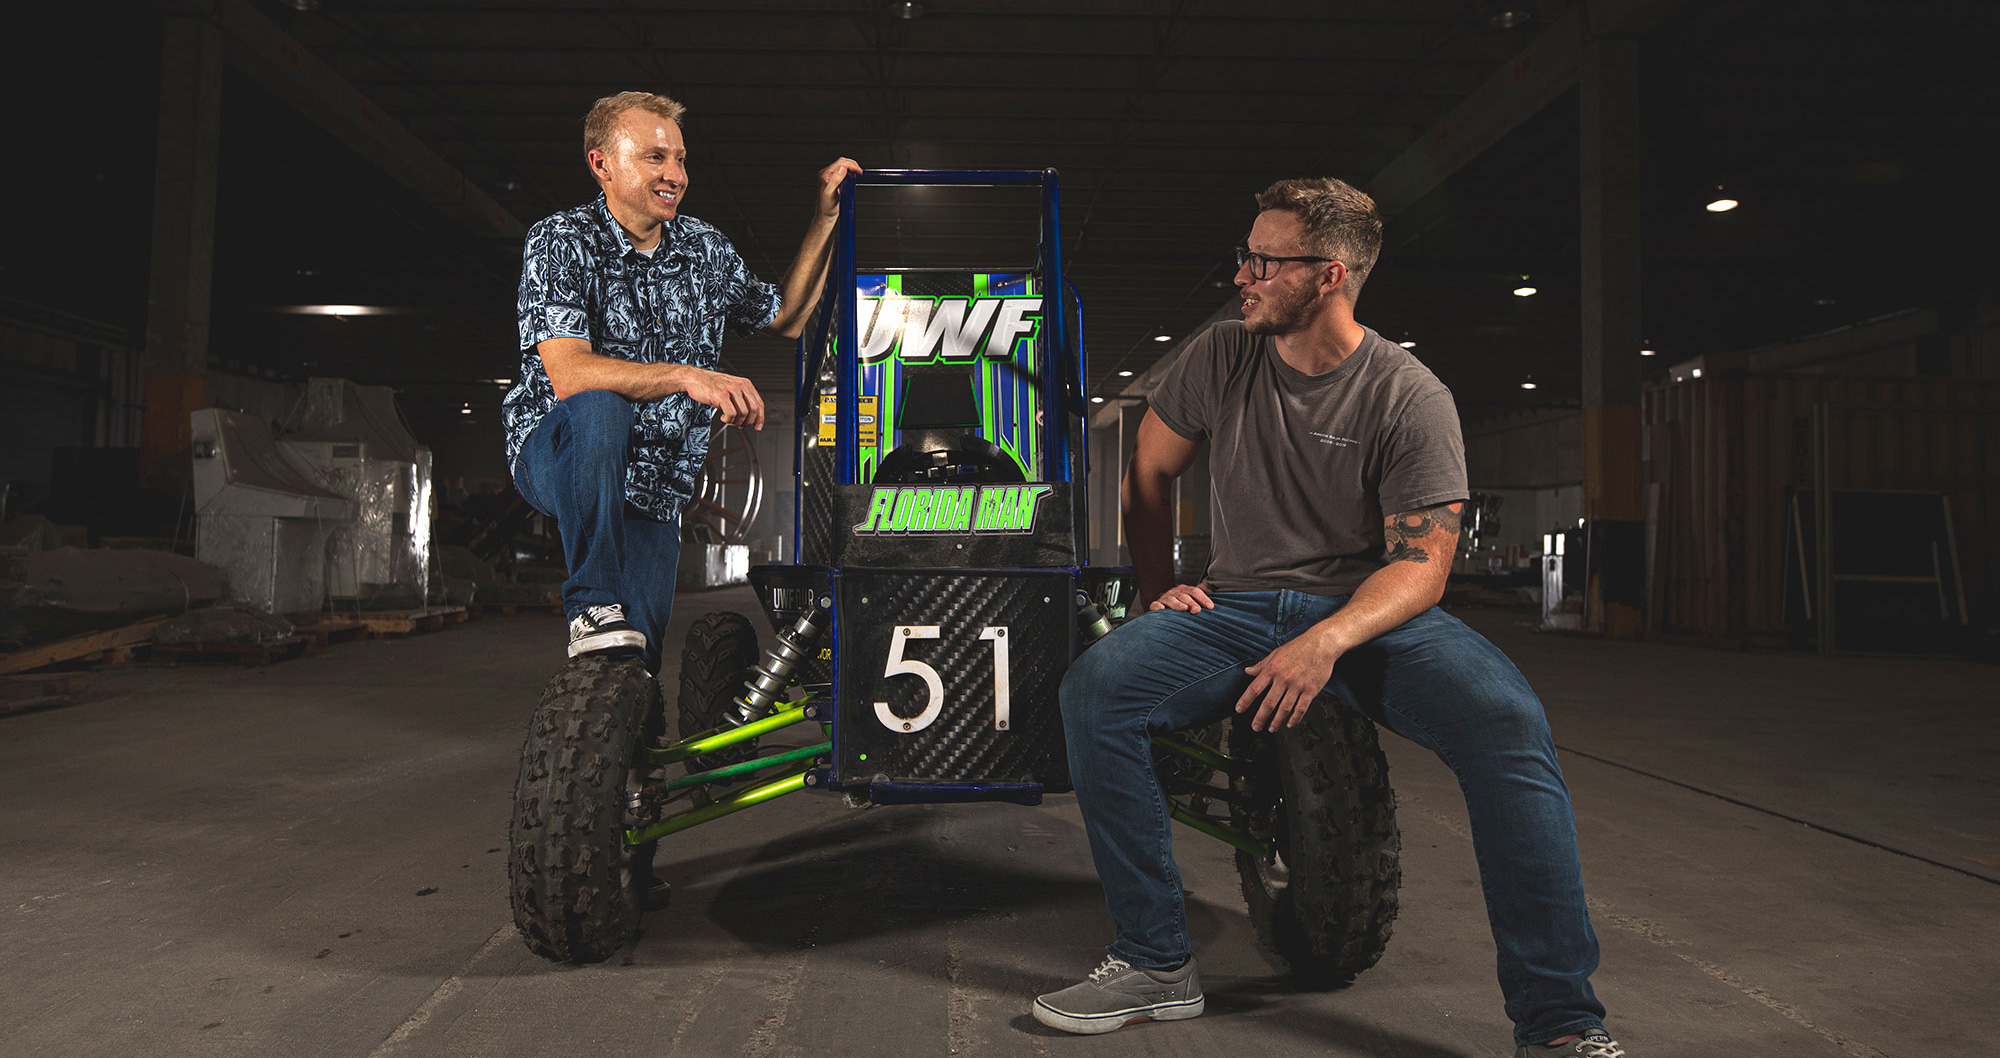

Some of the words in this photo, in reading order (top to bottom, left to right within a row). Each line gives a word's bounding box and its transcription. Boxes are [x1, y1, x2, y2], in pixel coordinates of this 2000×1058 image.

[857, 297, 1043, 360] UWF
[854, 487, 975, 533] FLORIDA
[973, 487, 1051, 532] MAN
[873, 625, 1010, 733] 51
